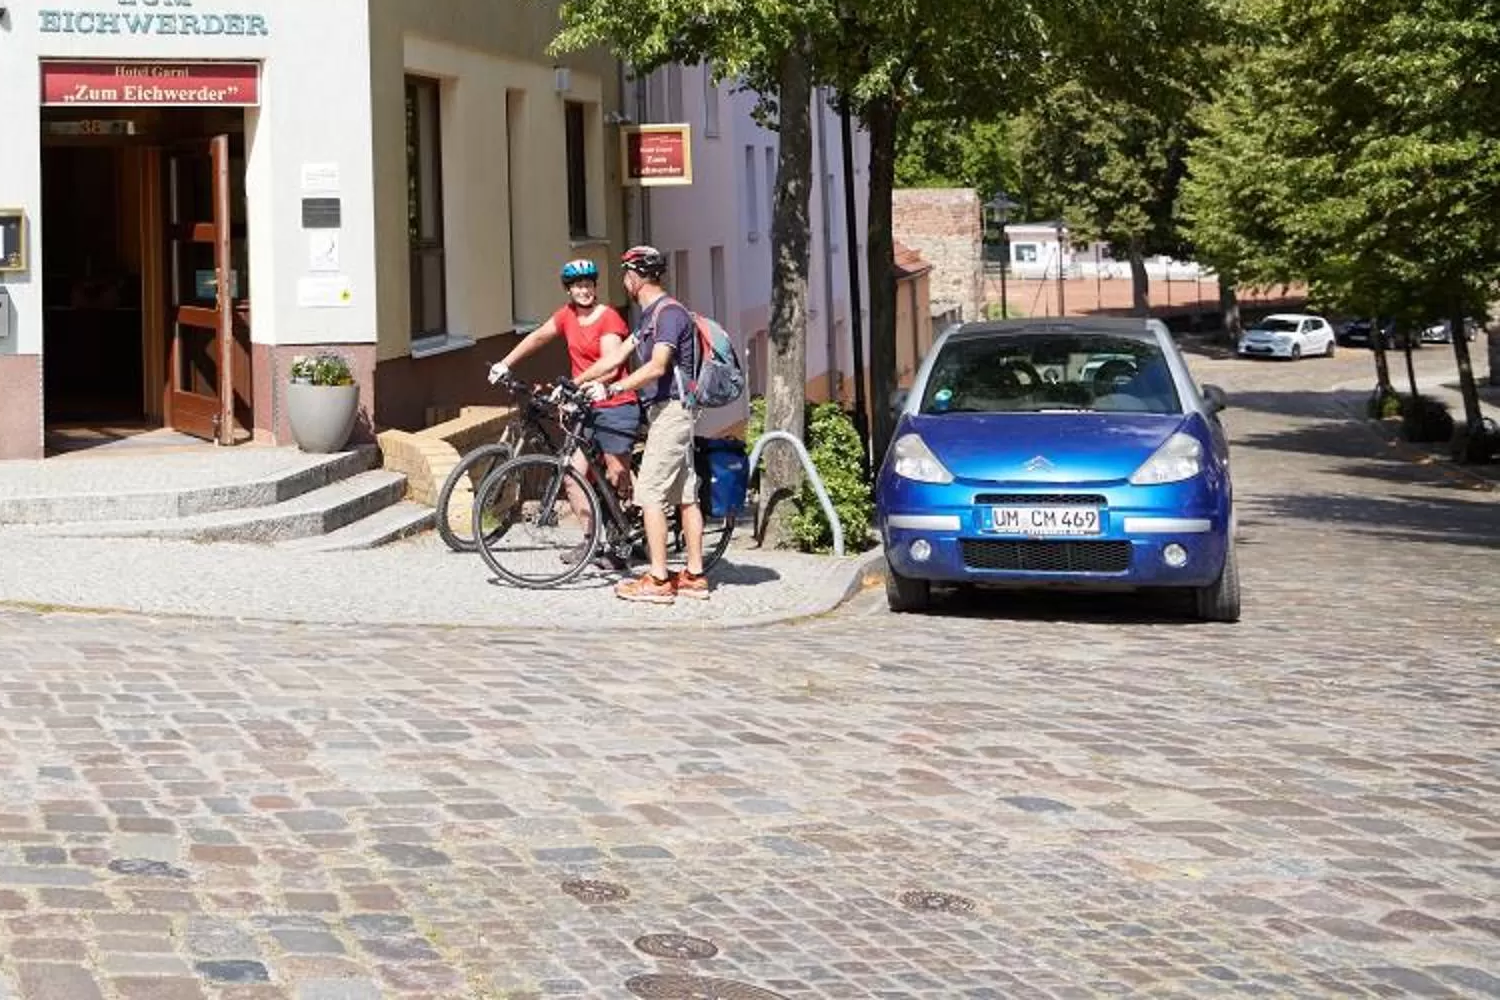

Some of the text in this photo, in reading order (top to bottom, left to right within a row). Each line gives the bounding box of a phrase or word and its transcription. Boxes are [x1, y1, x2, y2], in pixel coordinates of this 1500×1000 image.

[38, 9, 269, 36] EICHWERDER
[115, 65, 189, 78] Hotel Garni
[994, 510, 1097, 528] UM CM 469
